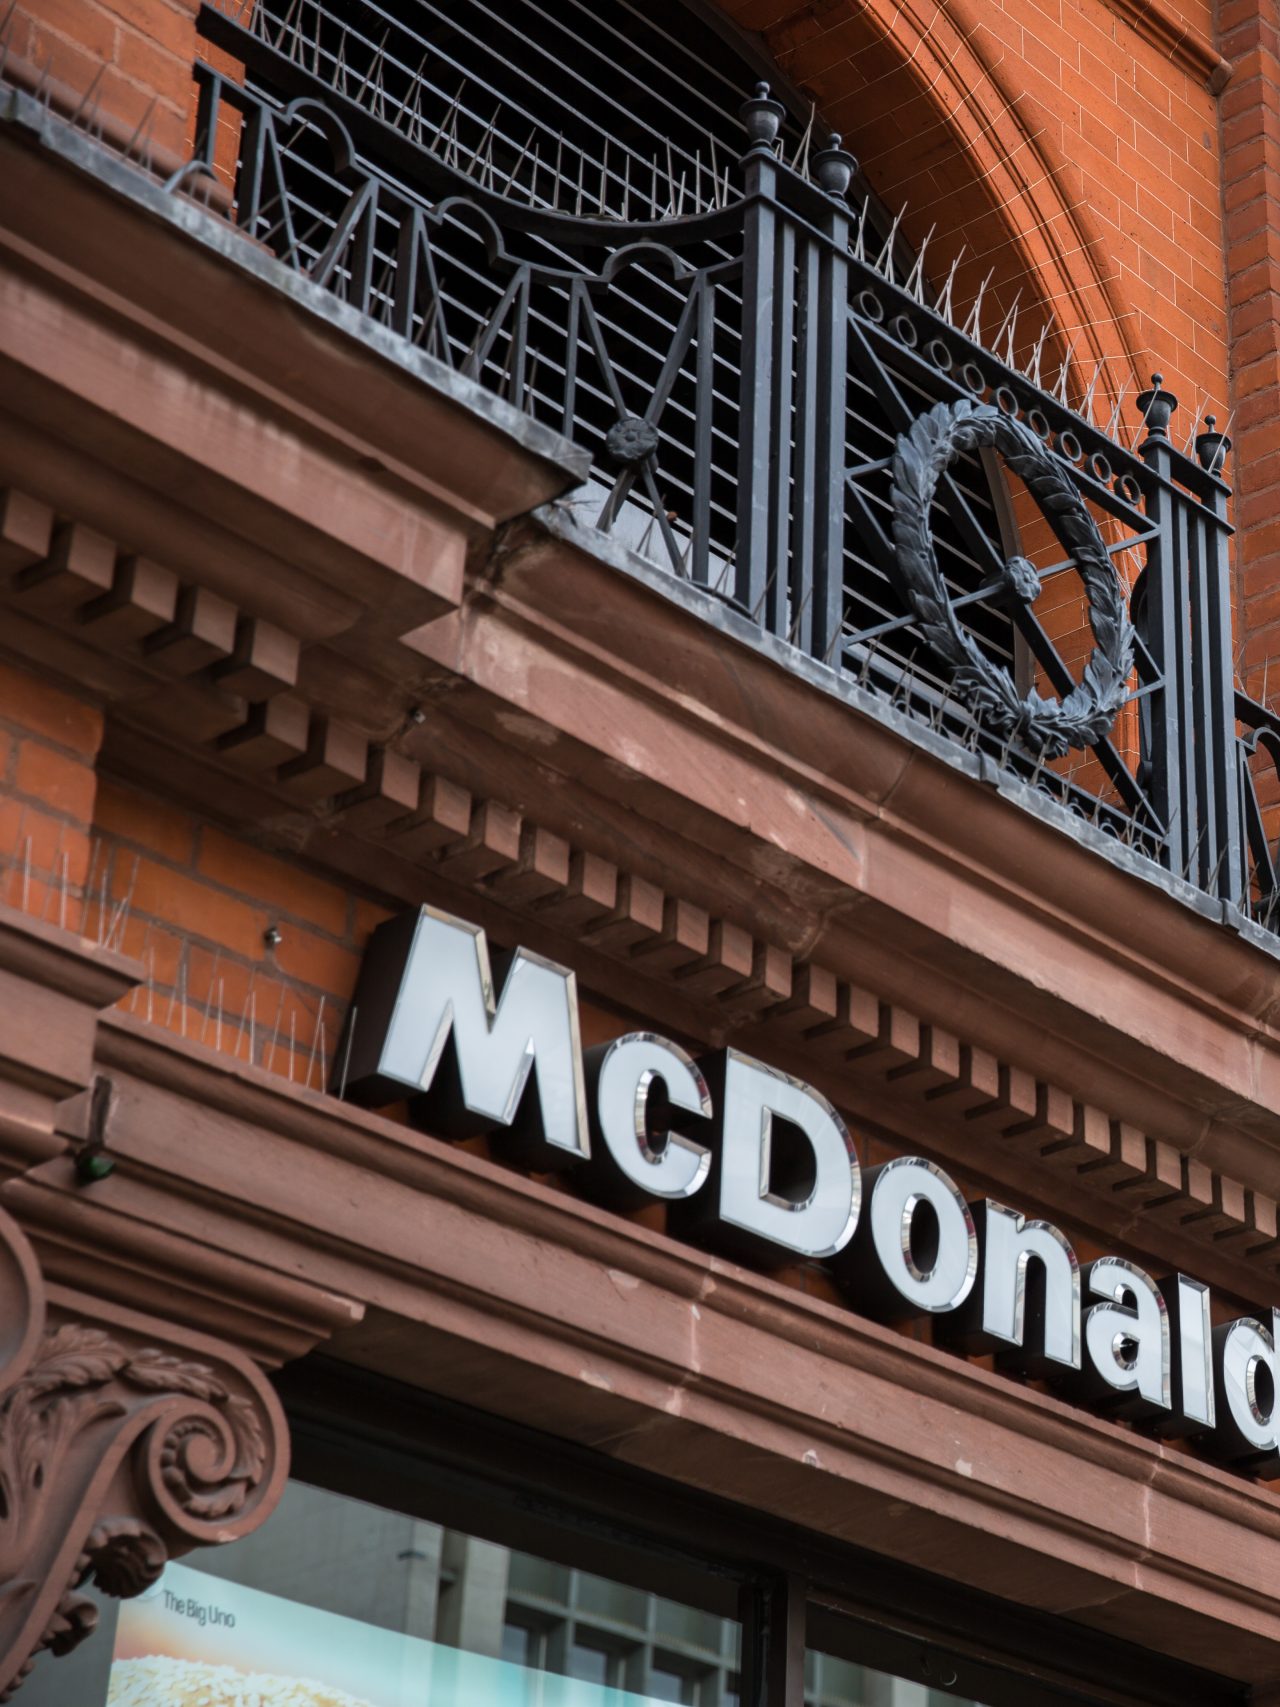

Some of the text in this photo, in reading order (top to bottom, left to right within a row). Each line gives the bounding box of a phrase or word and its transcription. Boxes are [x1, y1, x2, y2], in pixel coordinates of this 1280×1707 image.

[163, 1589, 236, 1628] The Big Uno
